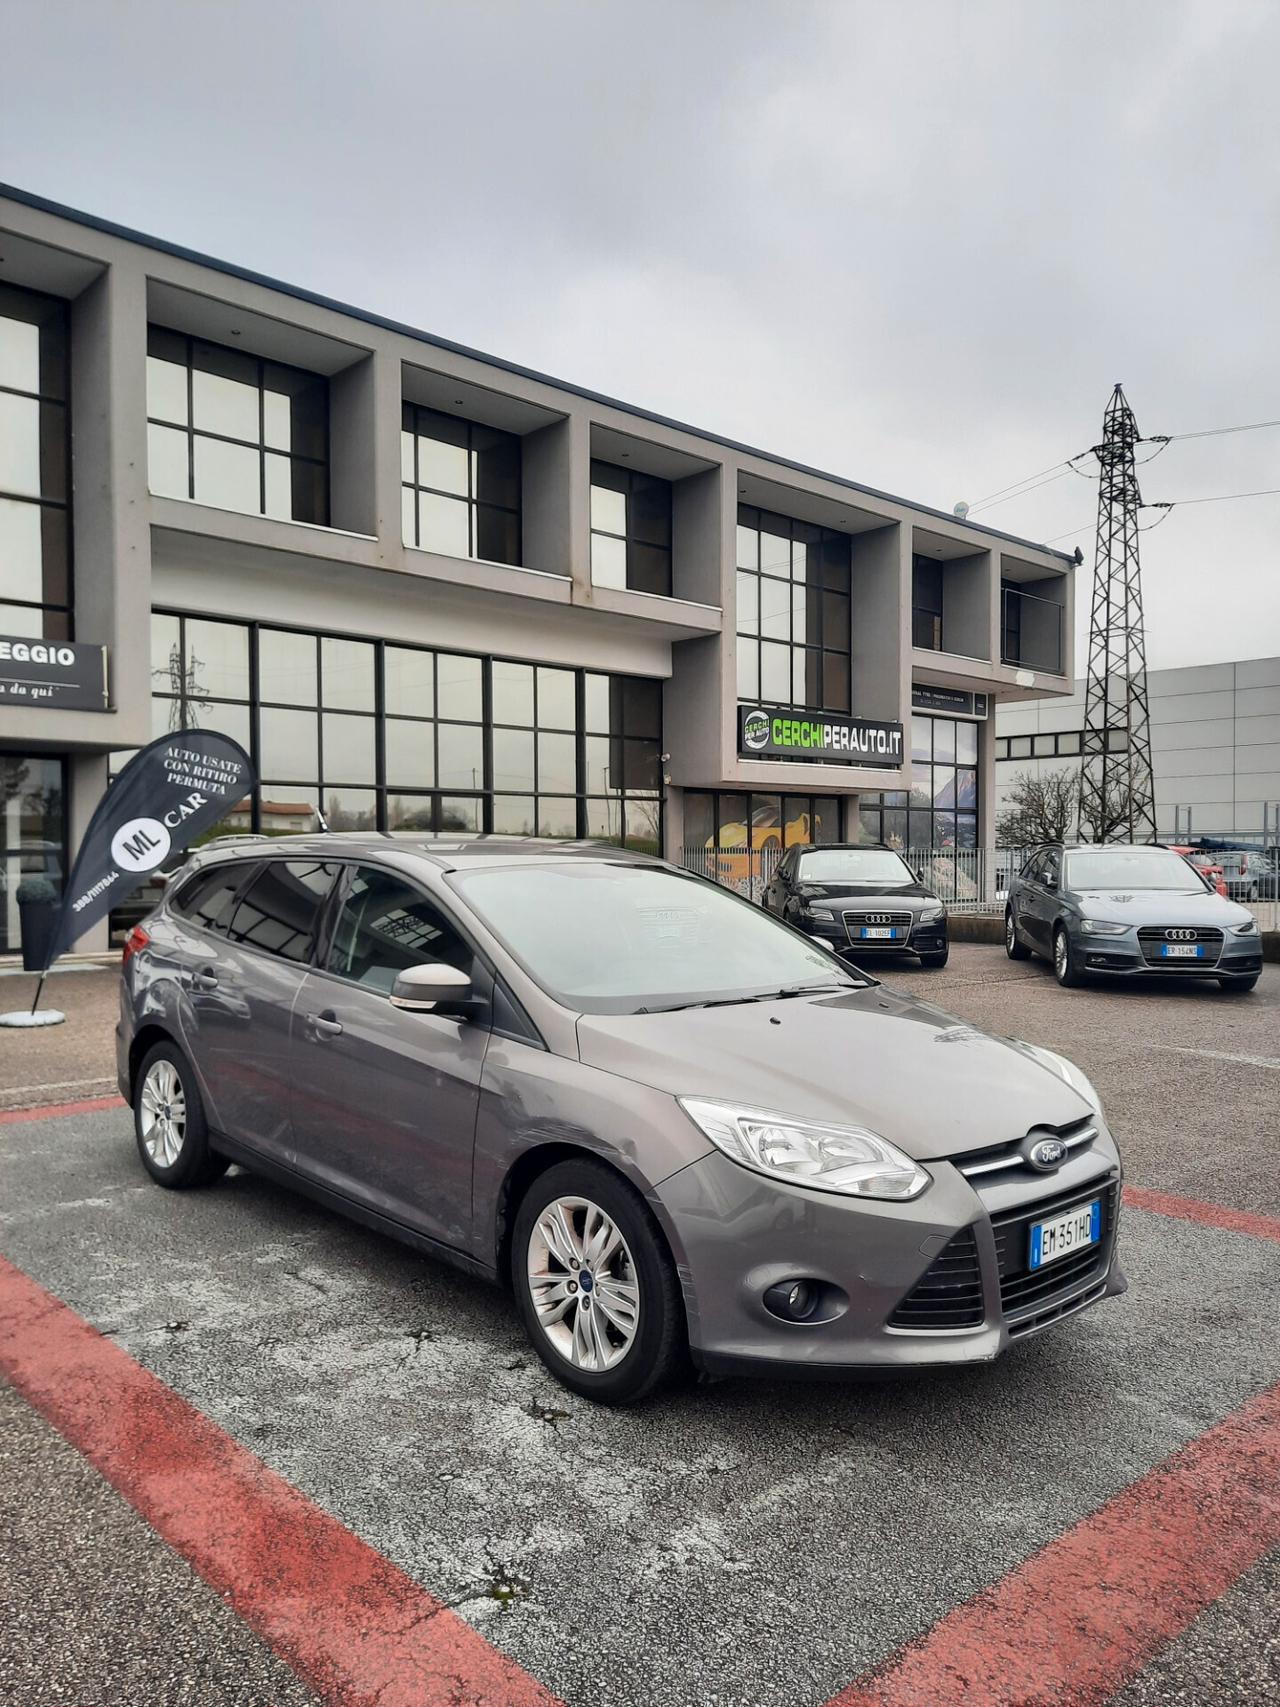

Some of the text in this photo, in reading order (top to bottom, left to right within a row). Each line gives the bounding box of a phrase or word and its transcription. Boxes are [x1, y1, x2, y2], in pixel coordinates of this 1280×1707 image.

[772, 719, 901, 754] CERCHIPERAUTO.IT
[163, 759, 237, 785] CON RITIRO
[164, 747, 242, 774] AUTO USATE
[167, 773, 225, 795] PERMUTA
[122, 792, 208, 861] ML CAR
[1041, 1144, 1061, 1161] Ford
[1042, 1227, 1056, 1256] EM
